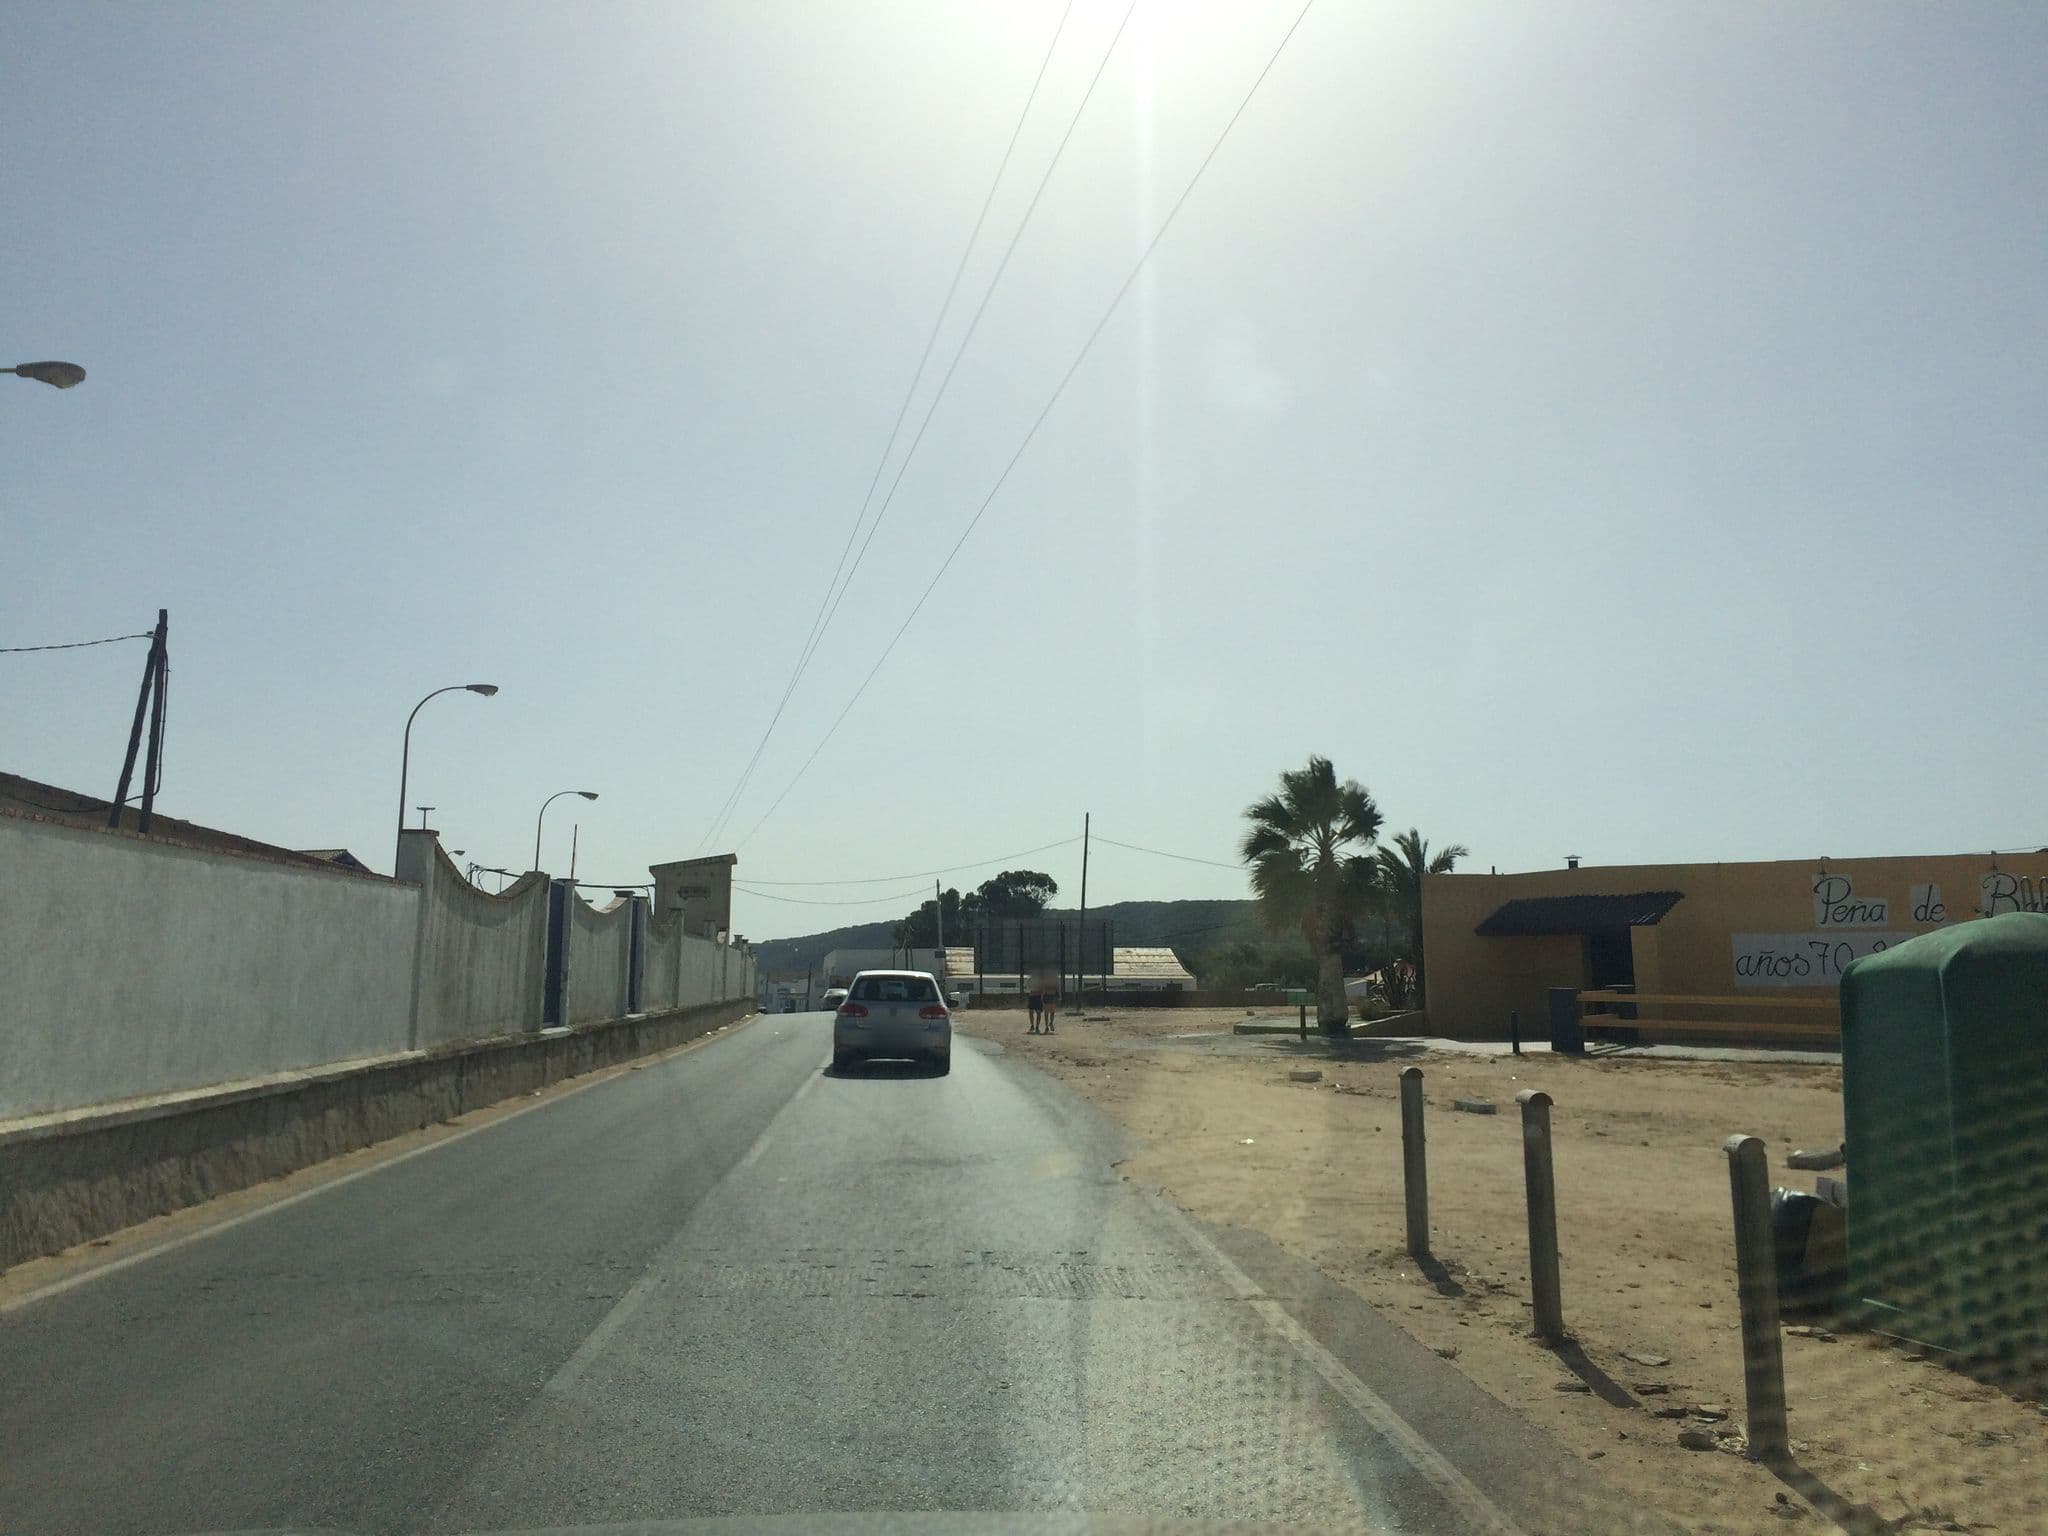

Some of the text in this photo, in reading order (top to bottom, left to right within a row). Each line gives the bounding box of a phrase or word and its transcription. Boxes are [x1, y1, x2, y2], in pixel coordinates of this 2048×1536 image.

[1813, 876, 1886, 924] Peña
[1914, 884, 1946, 922] de
[1736, 951, 1810, 977] años
